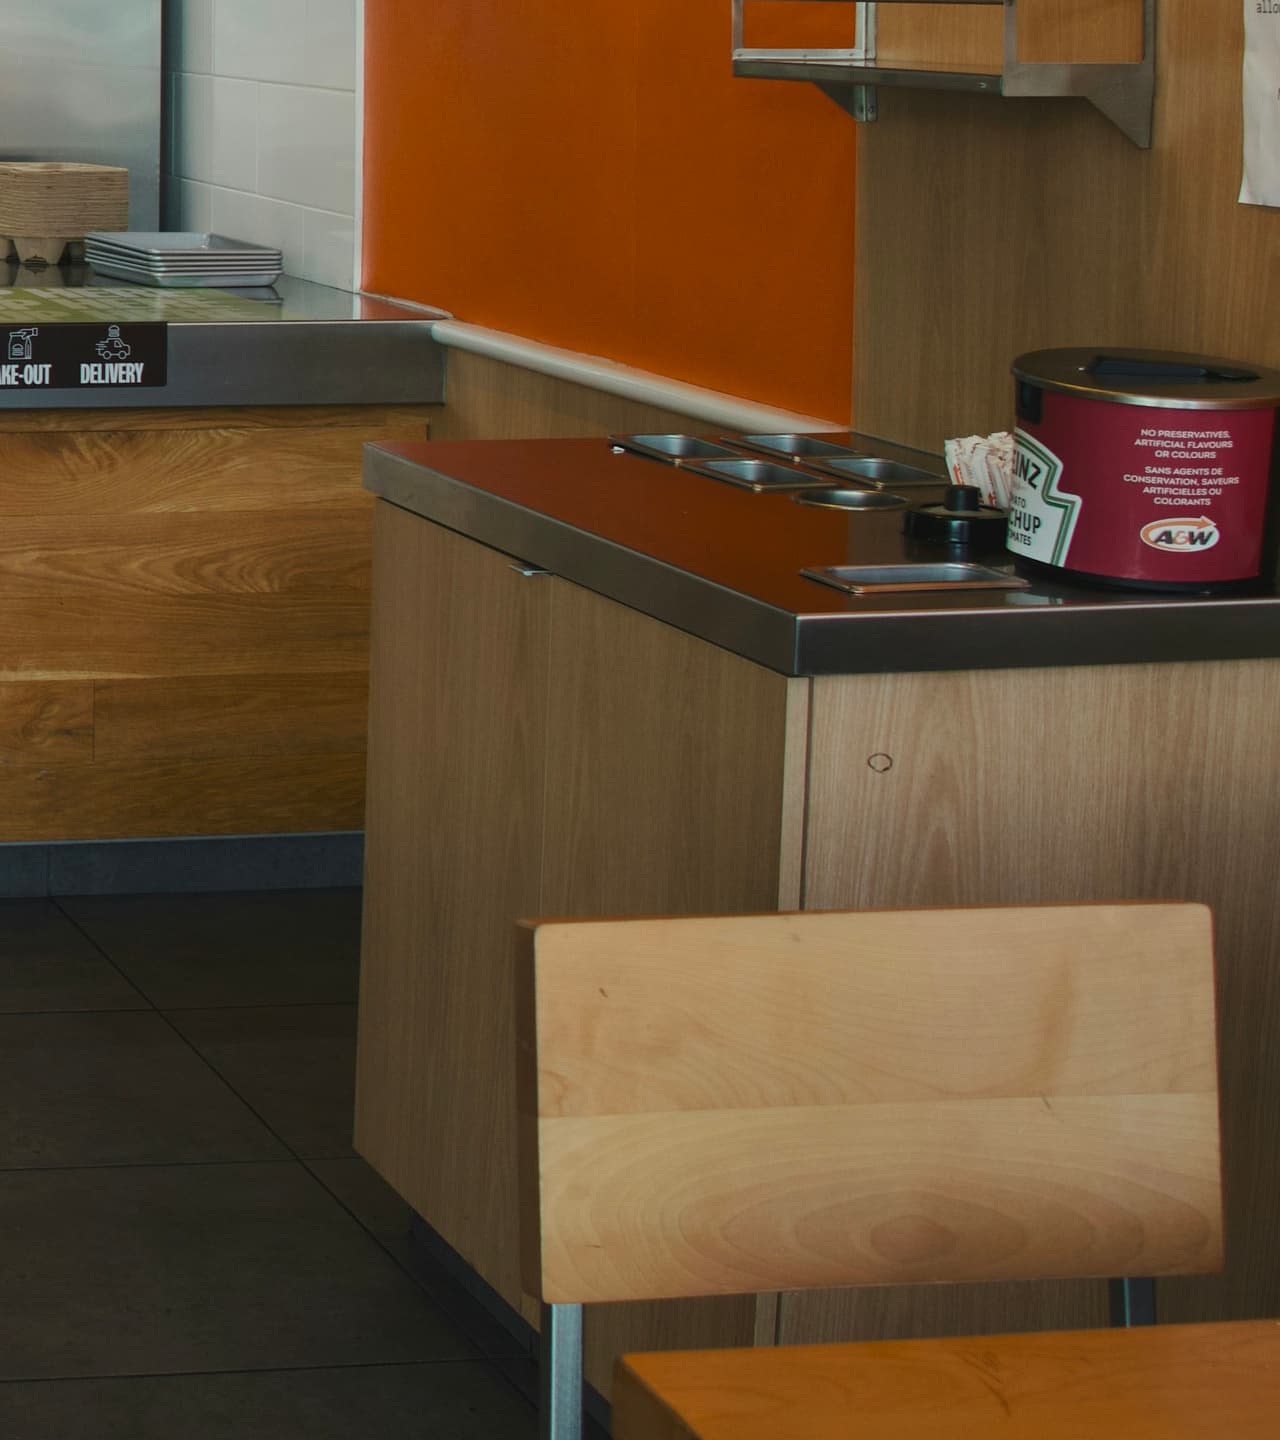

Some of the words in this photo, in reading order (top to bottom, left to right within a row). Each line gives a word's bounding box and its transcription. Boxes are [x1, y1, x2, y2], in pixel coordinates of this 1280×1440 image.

[80, 362, 144, 384] DELIVERY
[1134, 439, 1185, 448] ARTIFICIAL
[1155, 450, 1169, 458] OR
[1171, 451, 1216, 459] COLOURS
[1013, 450, 1041, 489] INZ
[1145, 466, 1171, 474] SANS
[1201, 477, 1239, 485] SAVEURS
[1143, 487, 1207, 495] ARTIFICIELLES
[1154, 497, 1211, 505] COLORANTS
[1155, 530, 1214, 545] A&W
